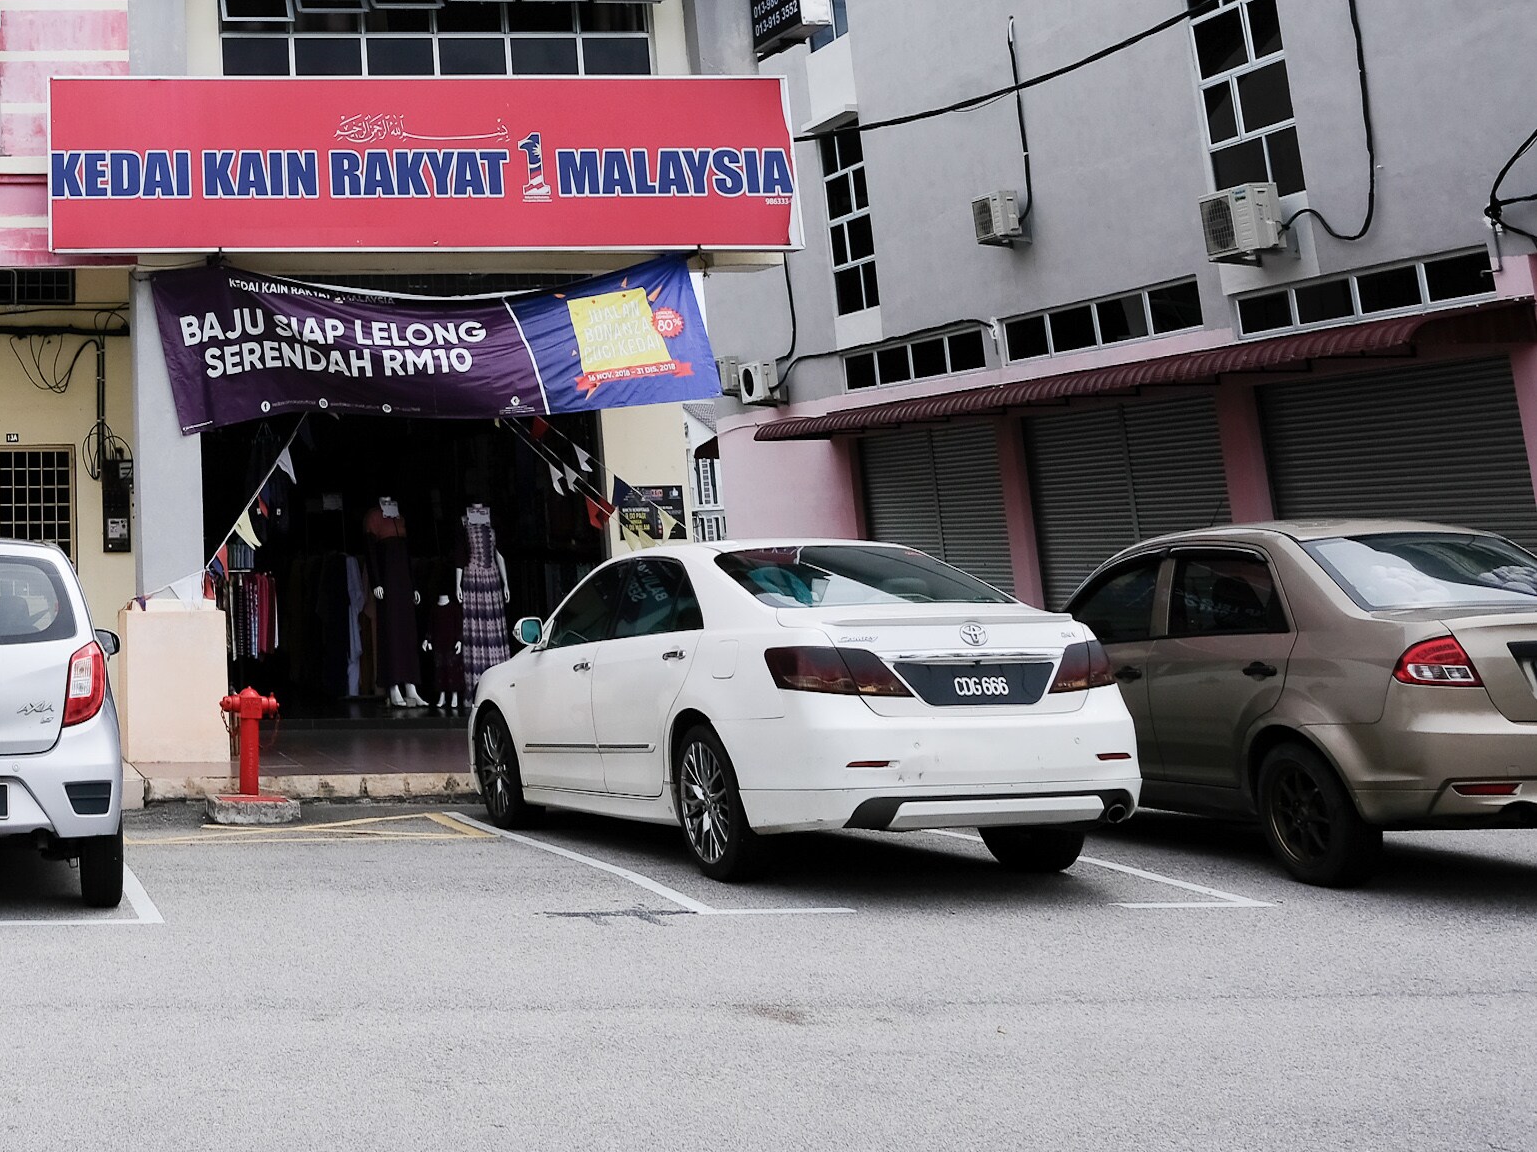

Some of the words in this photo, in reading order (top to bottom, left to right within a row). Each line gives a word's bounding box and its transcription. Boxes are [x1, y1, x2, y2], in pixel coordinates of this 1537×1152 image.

[755, 11, 780, 37] 013-915
[781, 0, 798, 20] 3552
[51, 149, 193, 198] KEDAI
[202, 149, 317, 198] KAIN
[329, 149, 509, 198] RAKYAT
[518, 132, 551, 195] 1
[556, 148, 793, 198] MALAYSIA
[262, 282, 289, 294] KAIN
[588, 300, 640, 324] JUALAN
[657, 318, 682, 332] 80%
[179, 308, 264, 346] BAJU
[273, 314, 345, 345] SIAP
[354, 319, 487, 347] LELONG
[584, 317, 651, 343] BONANZA
[205, 341, 373, 379] SERENDAH
[381, 347, 473, 376] RM10
[584, 345, 615, 364] CUCI
[618, 334, 661, 356] KEDAI
[597, 372, 614, 380] NOV.
[954, 677, 981, 697] CDG
[983, 677, 1009, 696] 666
